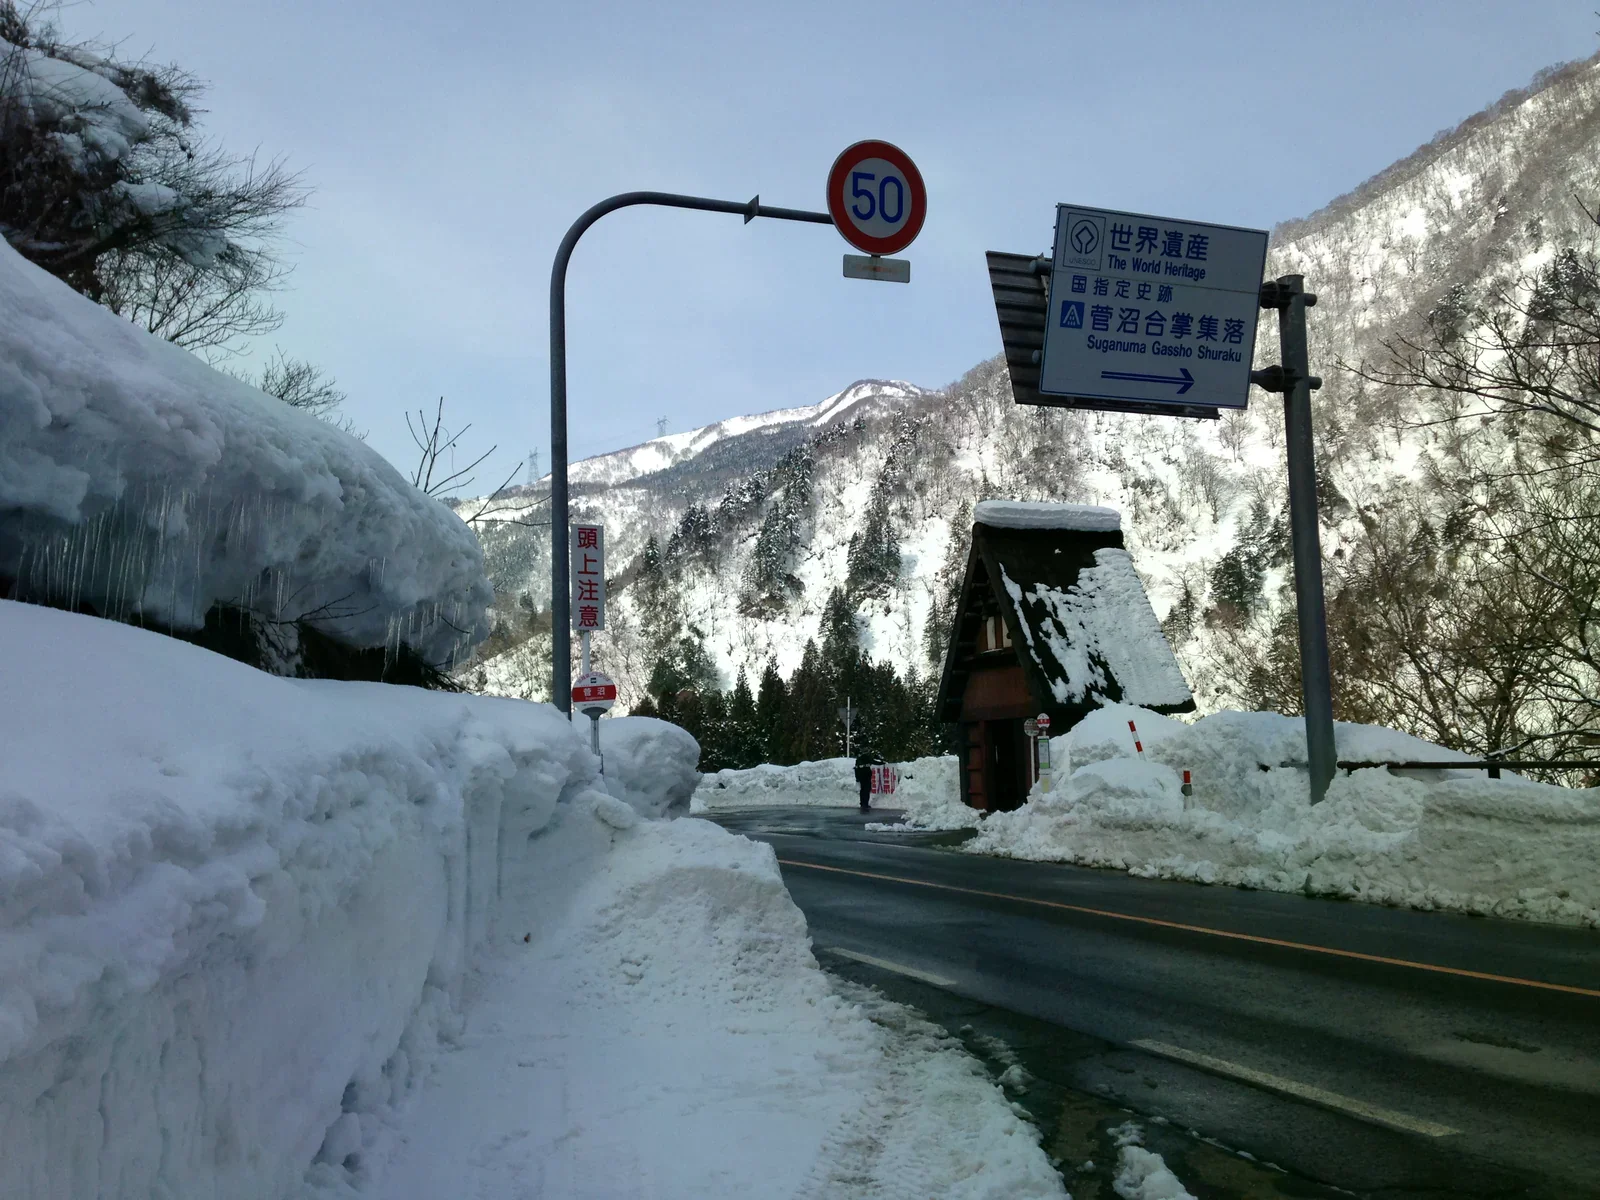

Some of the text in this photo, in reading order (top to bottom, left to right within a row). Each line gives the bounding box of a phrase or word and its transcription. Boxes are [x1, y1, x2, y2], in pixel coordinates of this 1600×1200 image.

[852, 171, 904, 224] 50
[1110, 222, 1209, 261] 世界遺産
[1108, 254, 1206, 281] The World Heritage
[1071, 275, 1174, 303] 国指定史跡
[1090, 304, 1246, 344] 菅沼合掌集落
[1087, 334, 1242, 362] Suganuma Gassho Shuraku
[577, 528, 599, 627] 頭上注意
